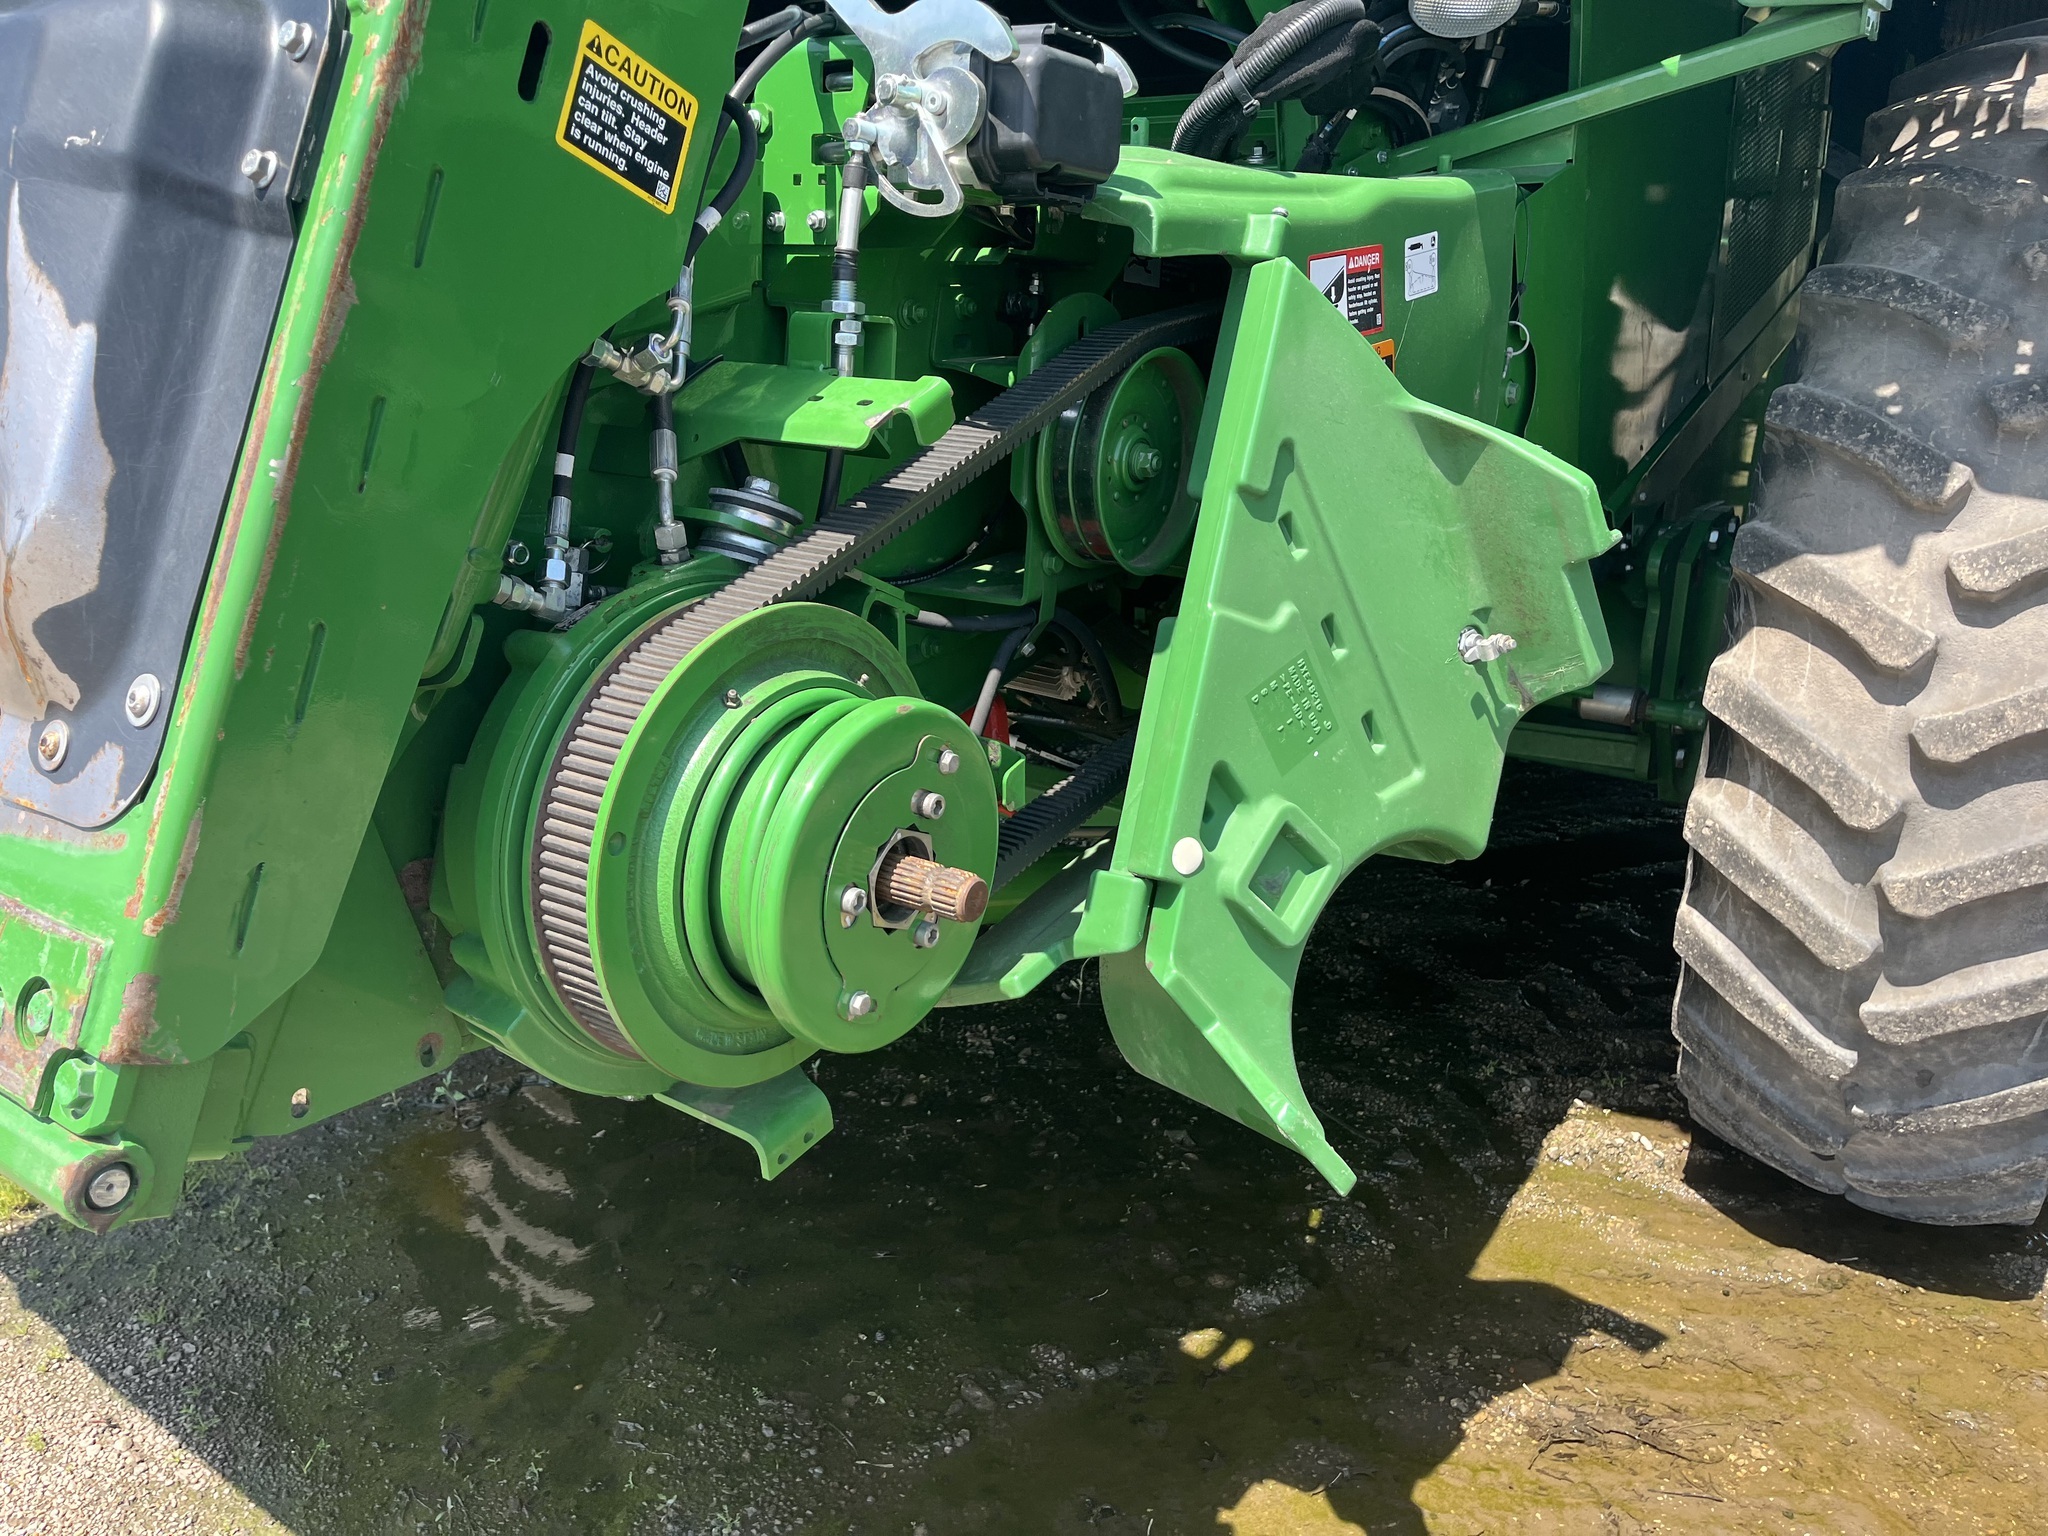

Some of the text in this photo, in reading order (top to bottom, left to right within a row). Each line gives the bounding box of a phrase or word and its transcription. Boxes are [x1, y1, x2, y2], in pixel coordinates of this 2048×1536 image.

[582, 78, 668, 146] injuries. Header
[585, 64, 666, 131] Avoid crushing
[605, 44, 692, 121] CAUTION
[571, 124, 628, 172] is running.
[574, 110, 670, 181] clear when engine
[578, 96, 648, 151] can tilt. Stay
[1354, 253, 1380, 268] DANGER
[1288, 666, 1321, 734] MADE IN USA
